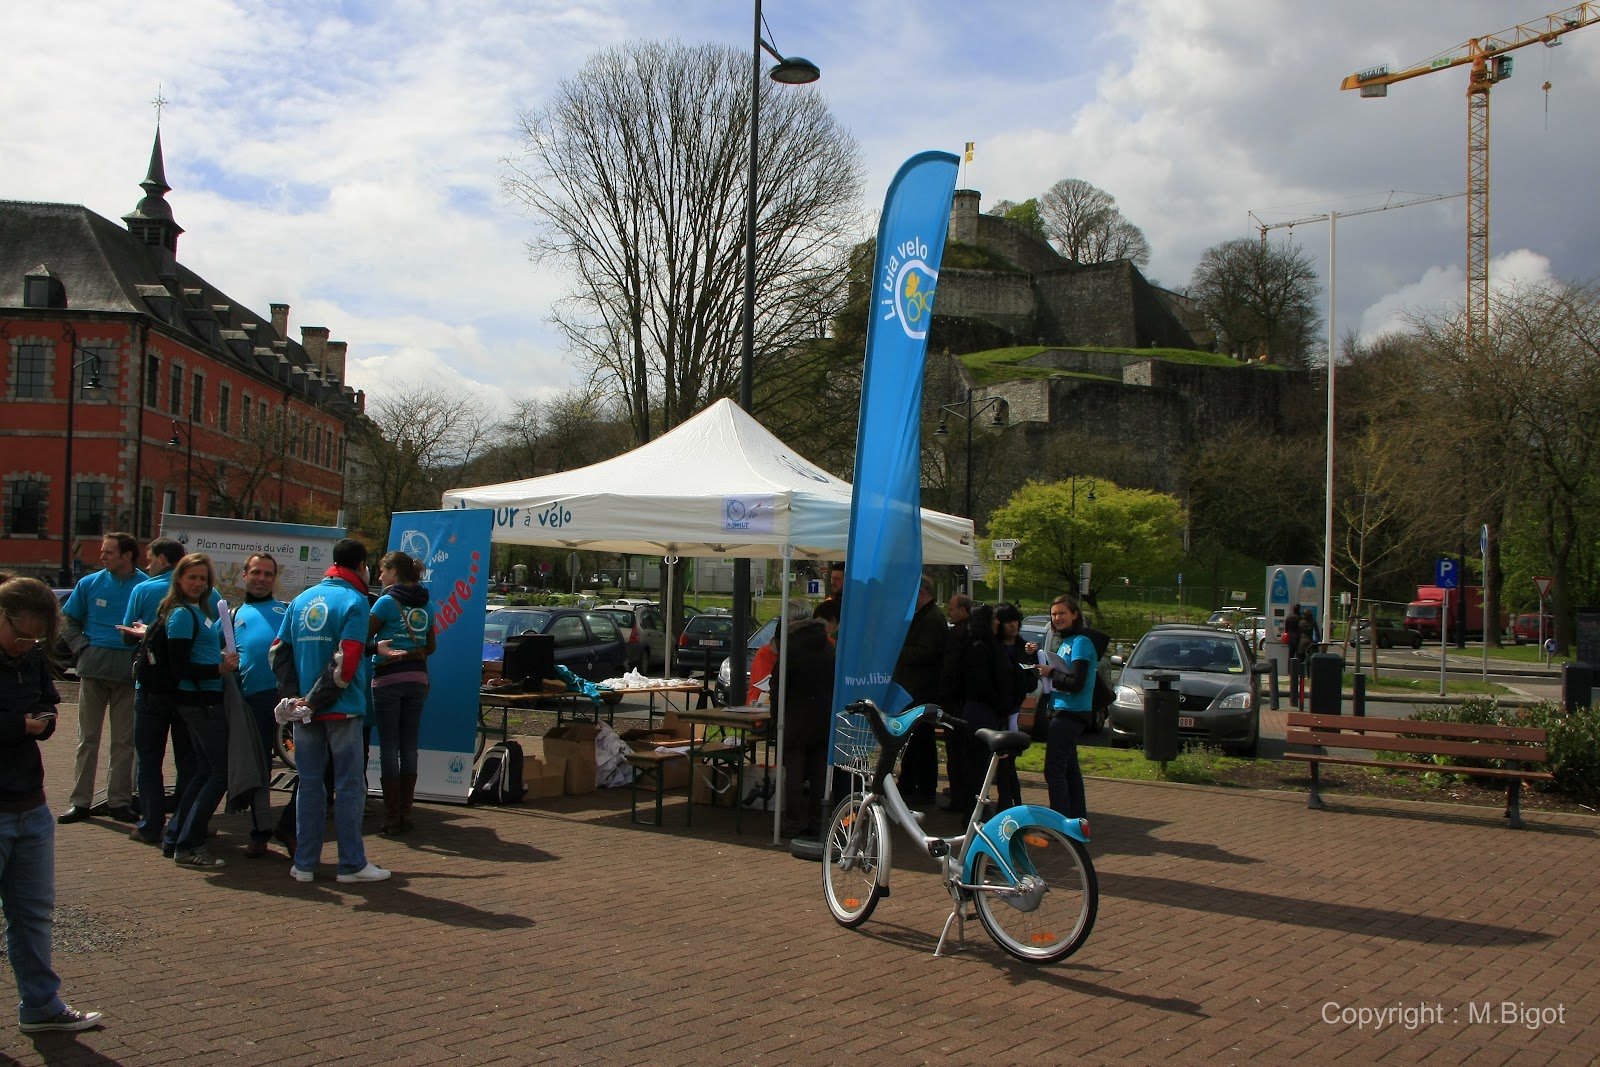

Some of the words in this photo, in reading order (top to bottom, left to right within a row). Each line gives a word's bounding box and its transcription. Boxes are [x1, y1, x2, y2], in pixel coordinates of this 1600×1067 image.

[882, 299, 897, 320] Li
[897, 236, 928, 260] velo
[524, 507, 532, 527] à
[538, 501, 572, 528] vélo
[196, 538, 218, 549] Plan
[220, 541, 262, 552] namurois
[263, 543, 275, 553] du
[276, 543, 295, 554] vélo
[1441, 561, 1453, 577] P
